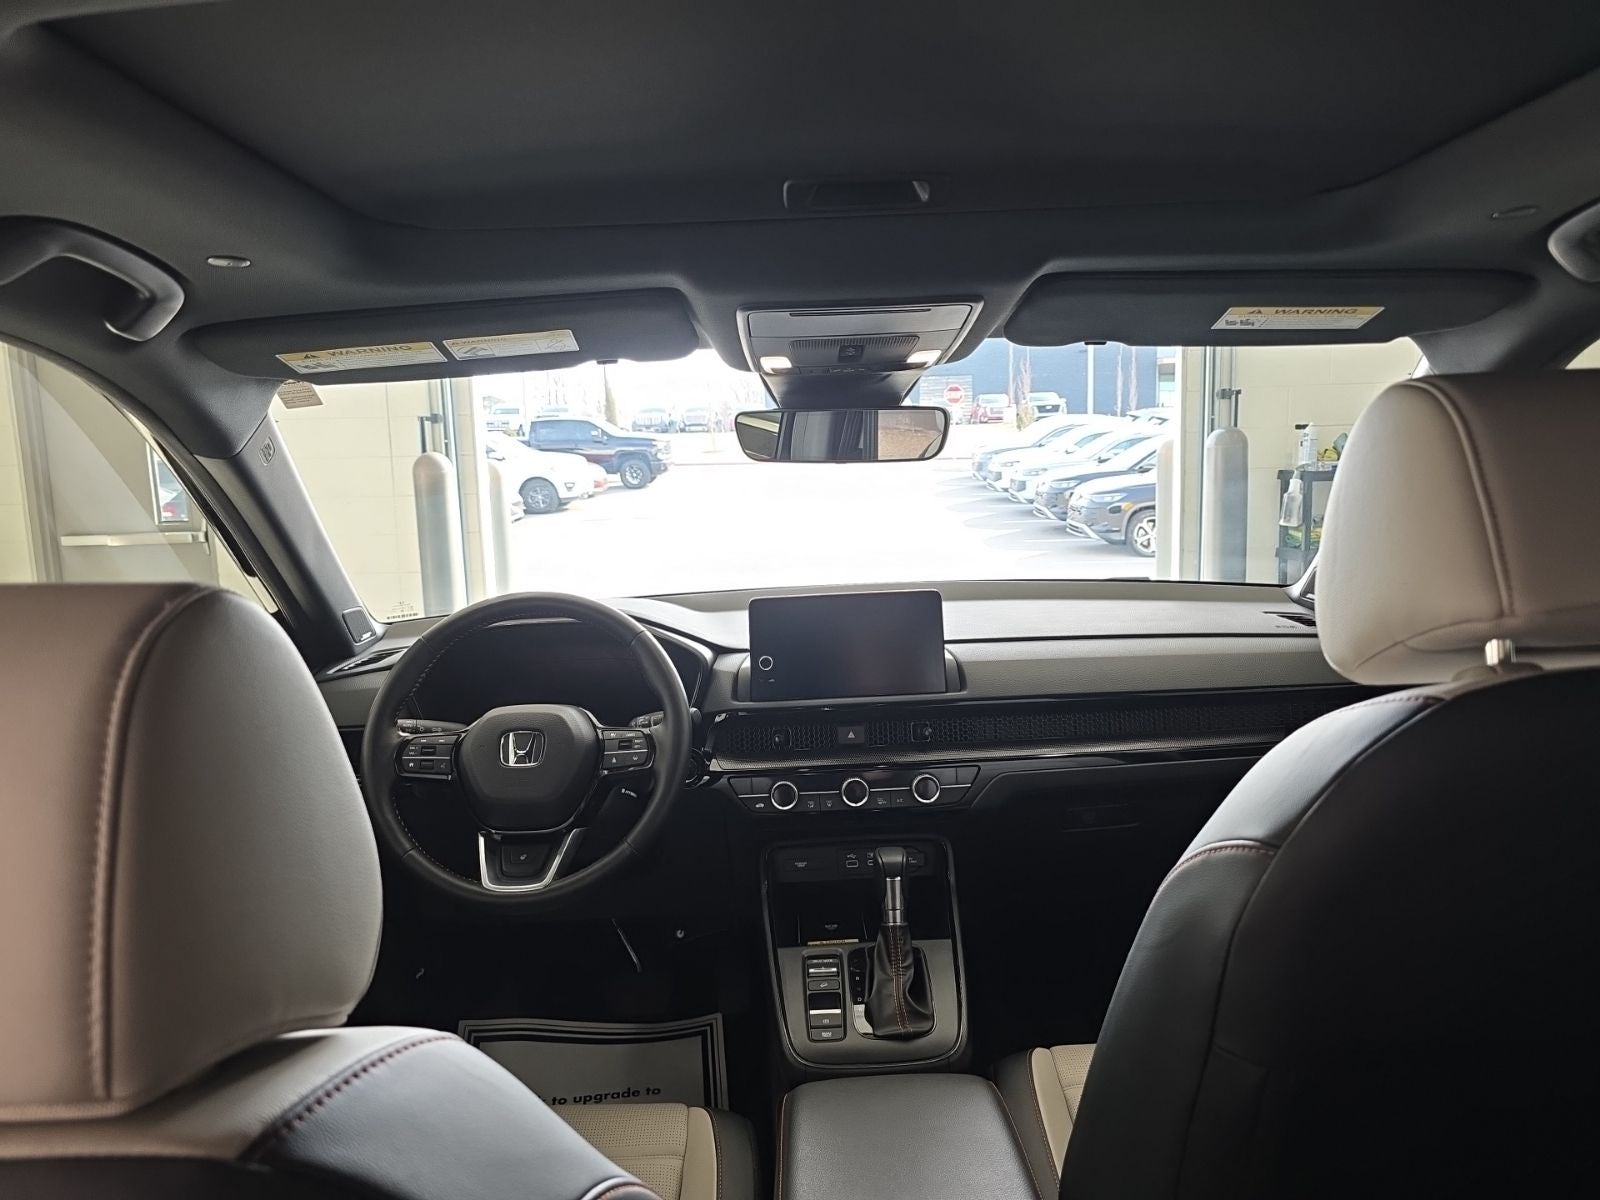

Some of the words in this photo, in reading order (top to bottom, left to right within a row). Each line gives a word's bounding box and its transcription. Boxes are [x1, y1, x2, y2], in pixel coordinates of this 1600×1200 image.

[327, 345, 412, 357] WARNING
[552, 1096, 567, 1105] to
[573, 1087, 640, 1104] upgrade
[646, 1087, 661, 1096] to
